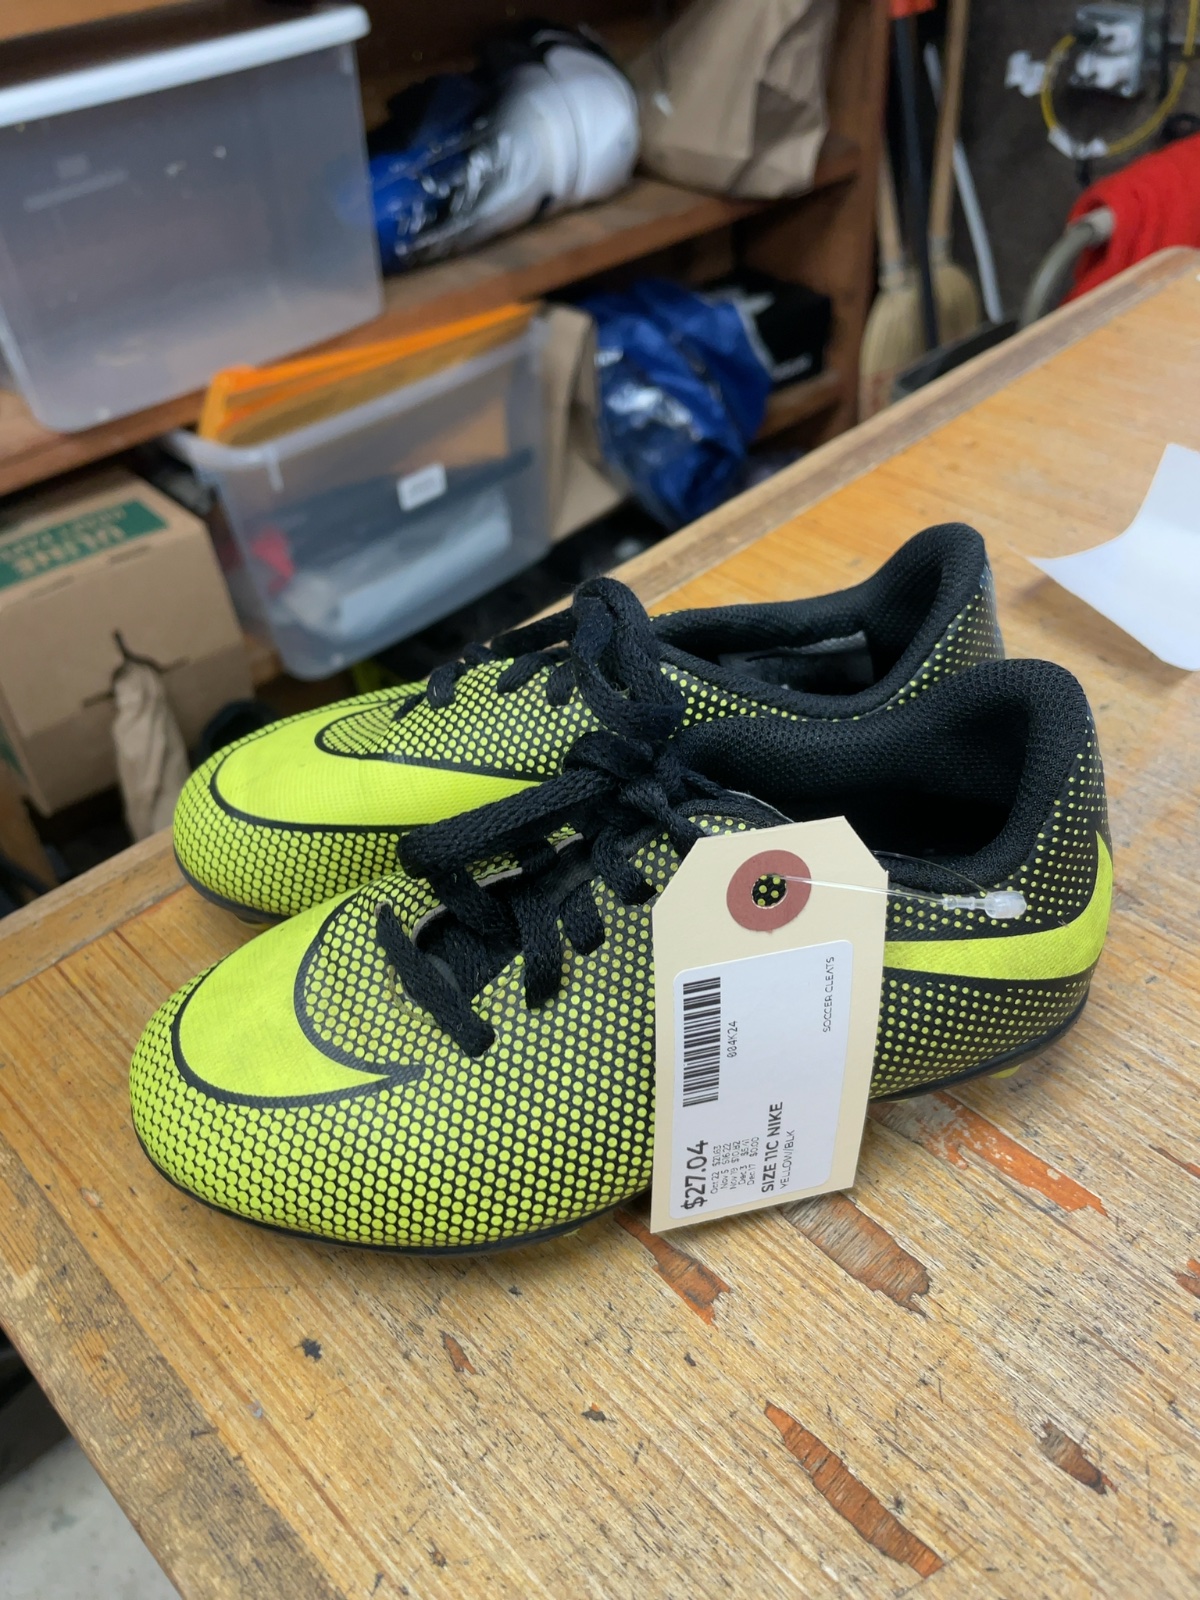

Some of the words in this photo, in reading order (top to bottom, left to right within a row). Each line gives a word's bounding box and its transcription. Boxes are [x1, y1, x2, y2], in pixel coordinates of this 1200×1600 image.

[825, 957, 834, 993] CLEATS
[823, 995, 832, 1032] SOCCER
[767, 1102, 783, 1138] NIKE
[749, 1137, 759, 1157] $0.00
[764, 1140, 779, 1162] 11C
[780, 1130, 795, 1189] YELLOW/BLK
[681, 1140, 708, 1209] $27.04
[712, 1171, 719, 1180] 22
[720, 1176, 728, 1189] Nov
[738, 1171, 746, 1185] Dec
[747, 1171, 755, 1185] Dec
[761, 1163, 776, 1192] SIZE
[710, 1181, 718, 1194] Oct
